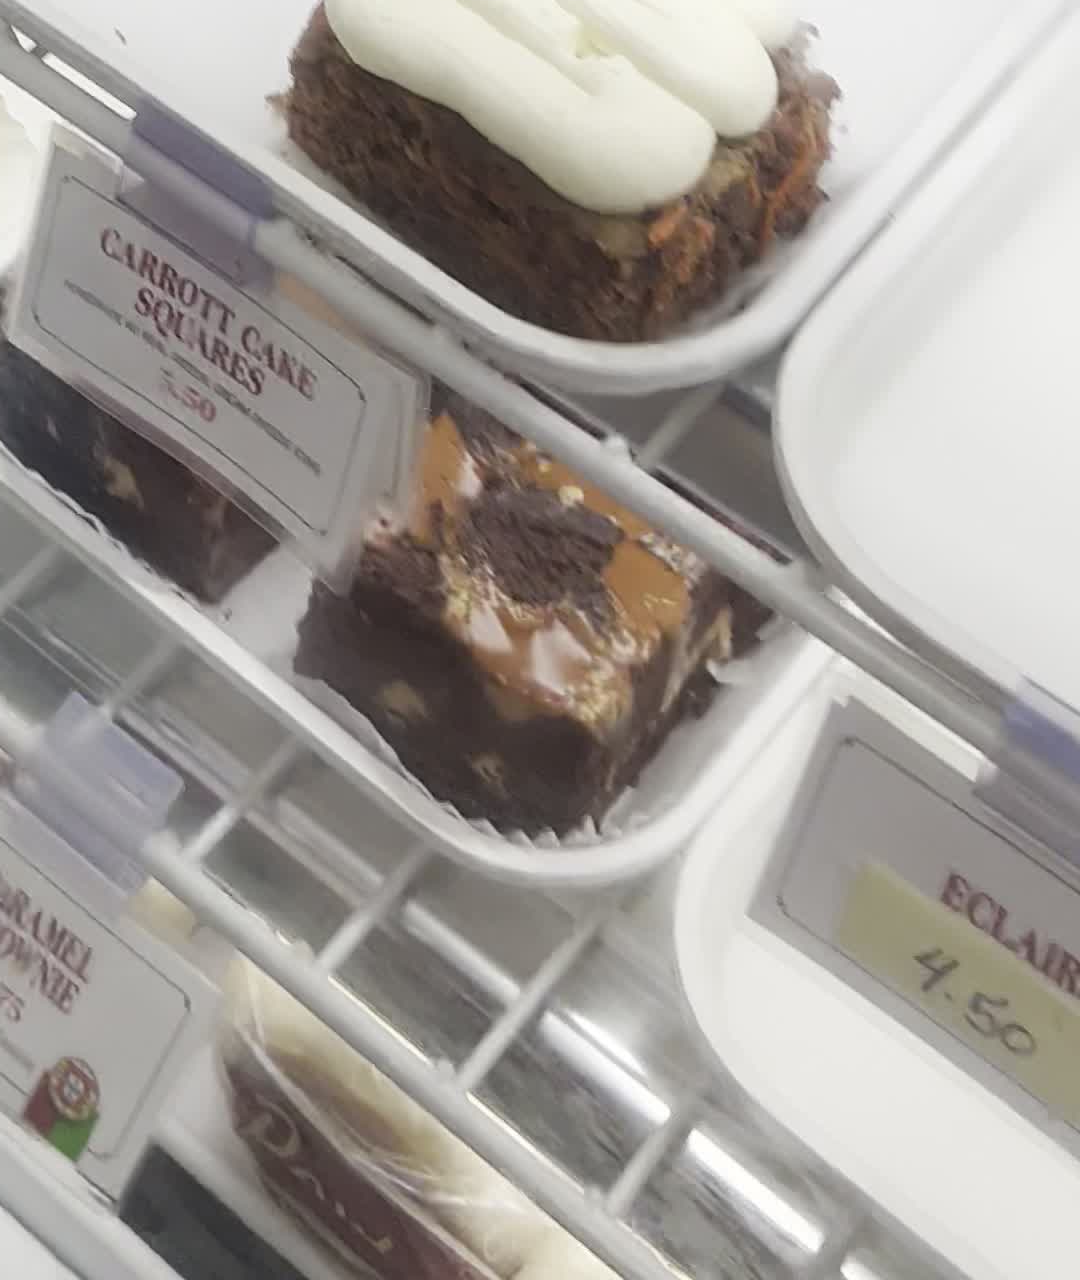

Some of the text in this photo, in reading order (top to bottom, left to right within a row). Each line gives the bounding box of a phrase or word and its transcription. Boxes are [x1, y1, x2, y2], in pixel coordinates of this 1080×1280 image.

[100, 227, 236, 333] CARROTT
[241, 325, 318, 401] CAKE
[134, 287, 264, 396] SQUARES
[914, 947, 1037, 1056] 4.50
